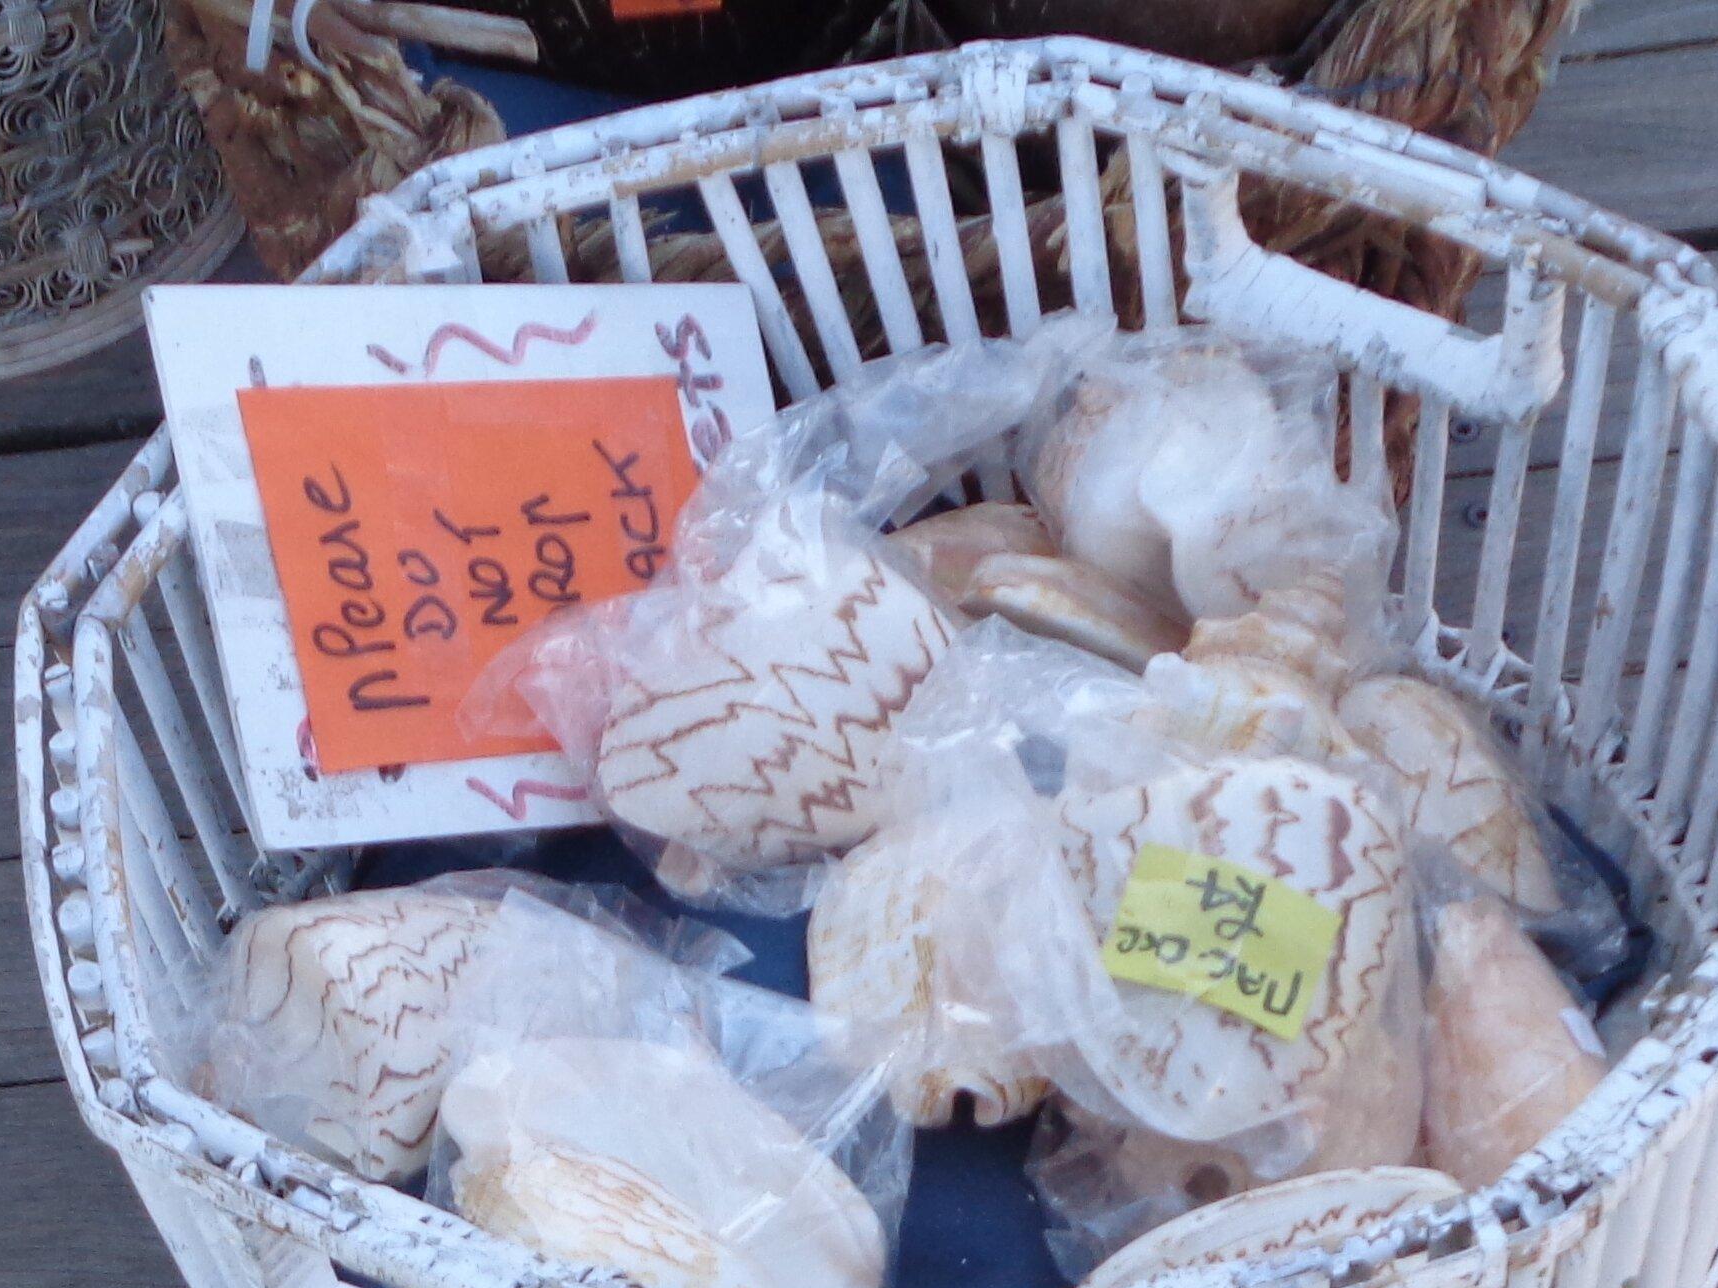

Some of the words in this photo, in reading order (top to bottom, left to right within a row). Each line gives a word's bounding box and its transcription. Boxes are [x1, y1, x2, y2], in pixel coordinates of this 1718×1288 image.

[434, 508, 519, 626] NOT
[521, 494, 591, 606] ROP
[592, 440, 667, 580] ACK
